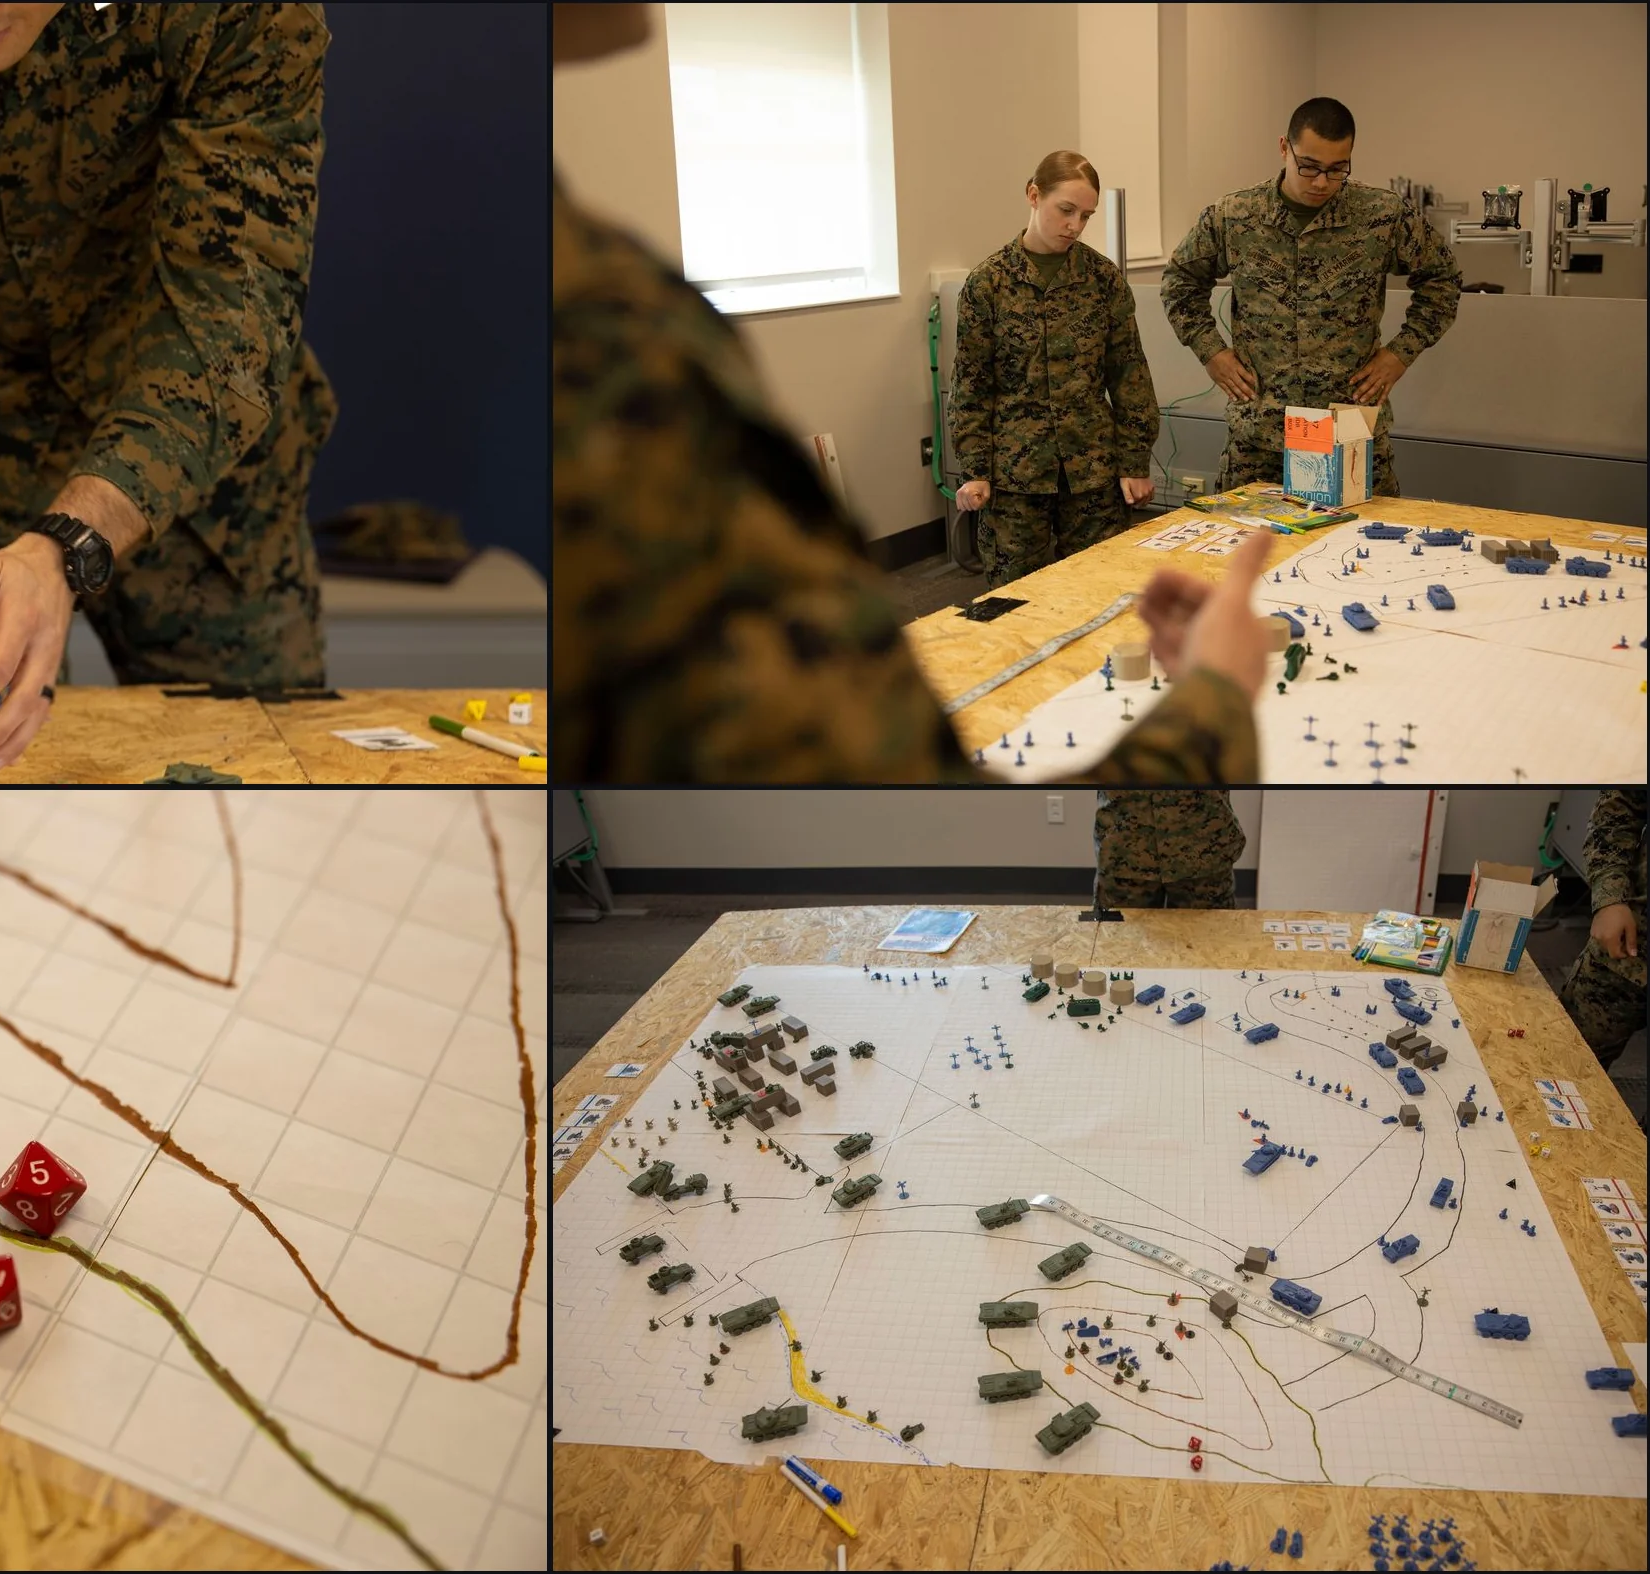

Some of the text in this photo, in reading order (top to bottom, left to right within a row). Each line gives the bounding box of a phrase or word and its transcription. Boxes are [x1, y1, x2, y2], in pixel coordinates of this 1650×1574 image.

[1333, 250, 1364, 272] MARINES
[29, 1159, 50, 1185] 5
[15, 1199, 39, 1221] 8
